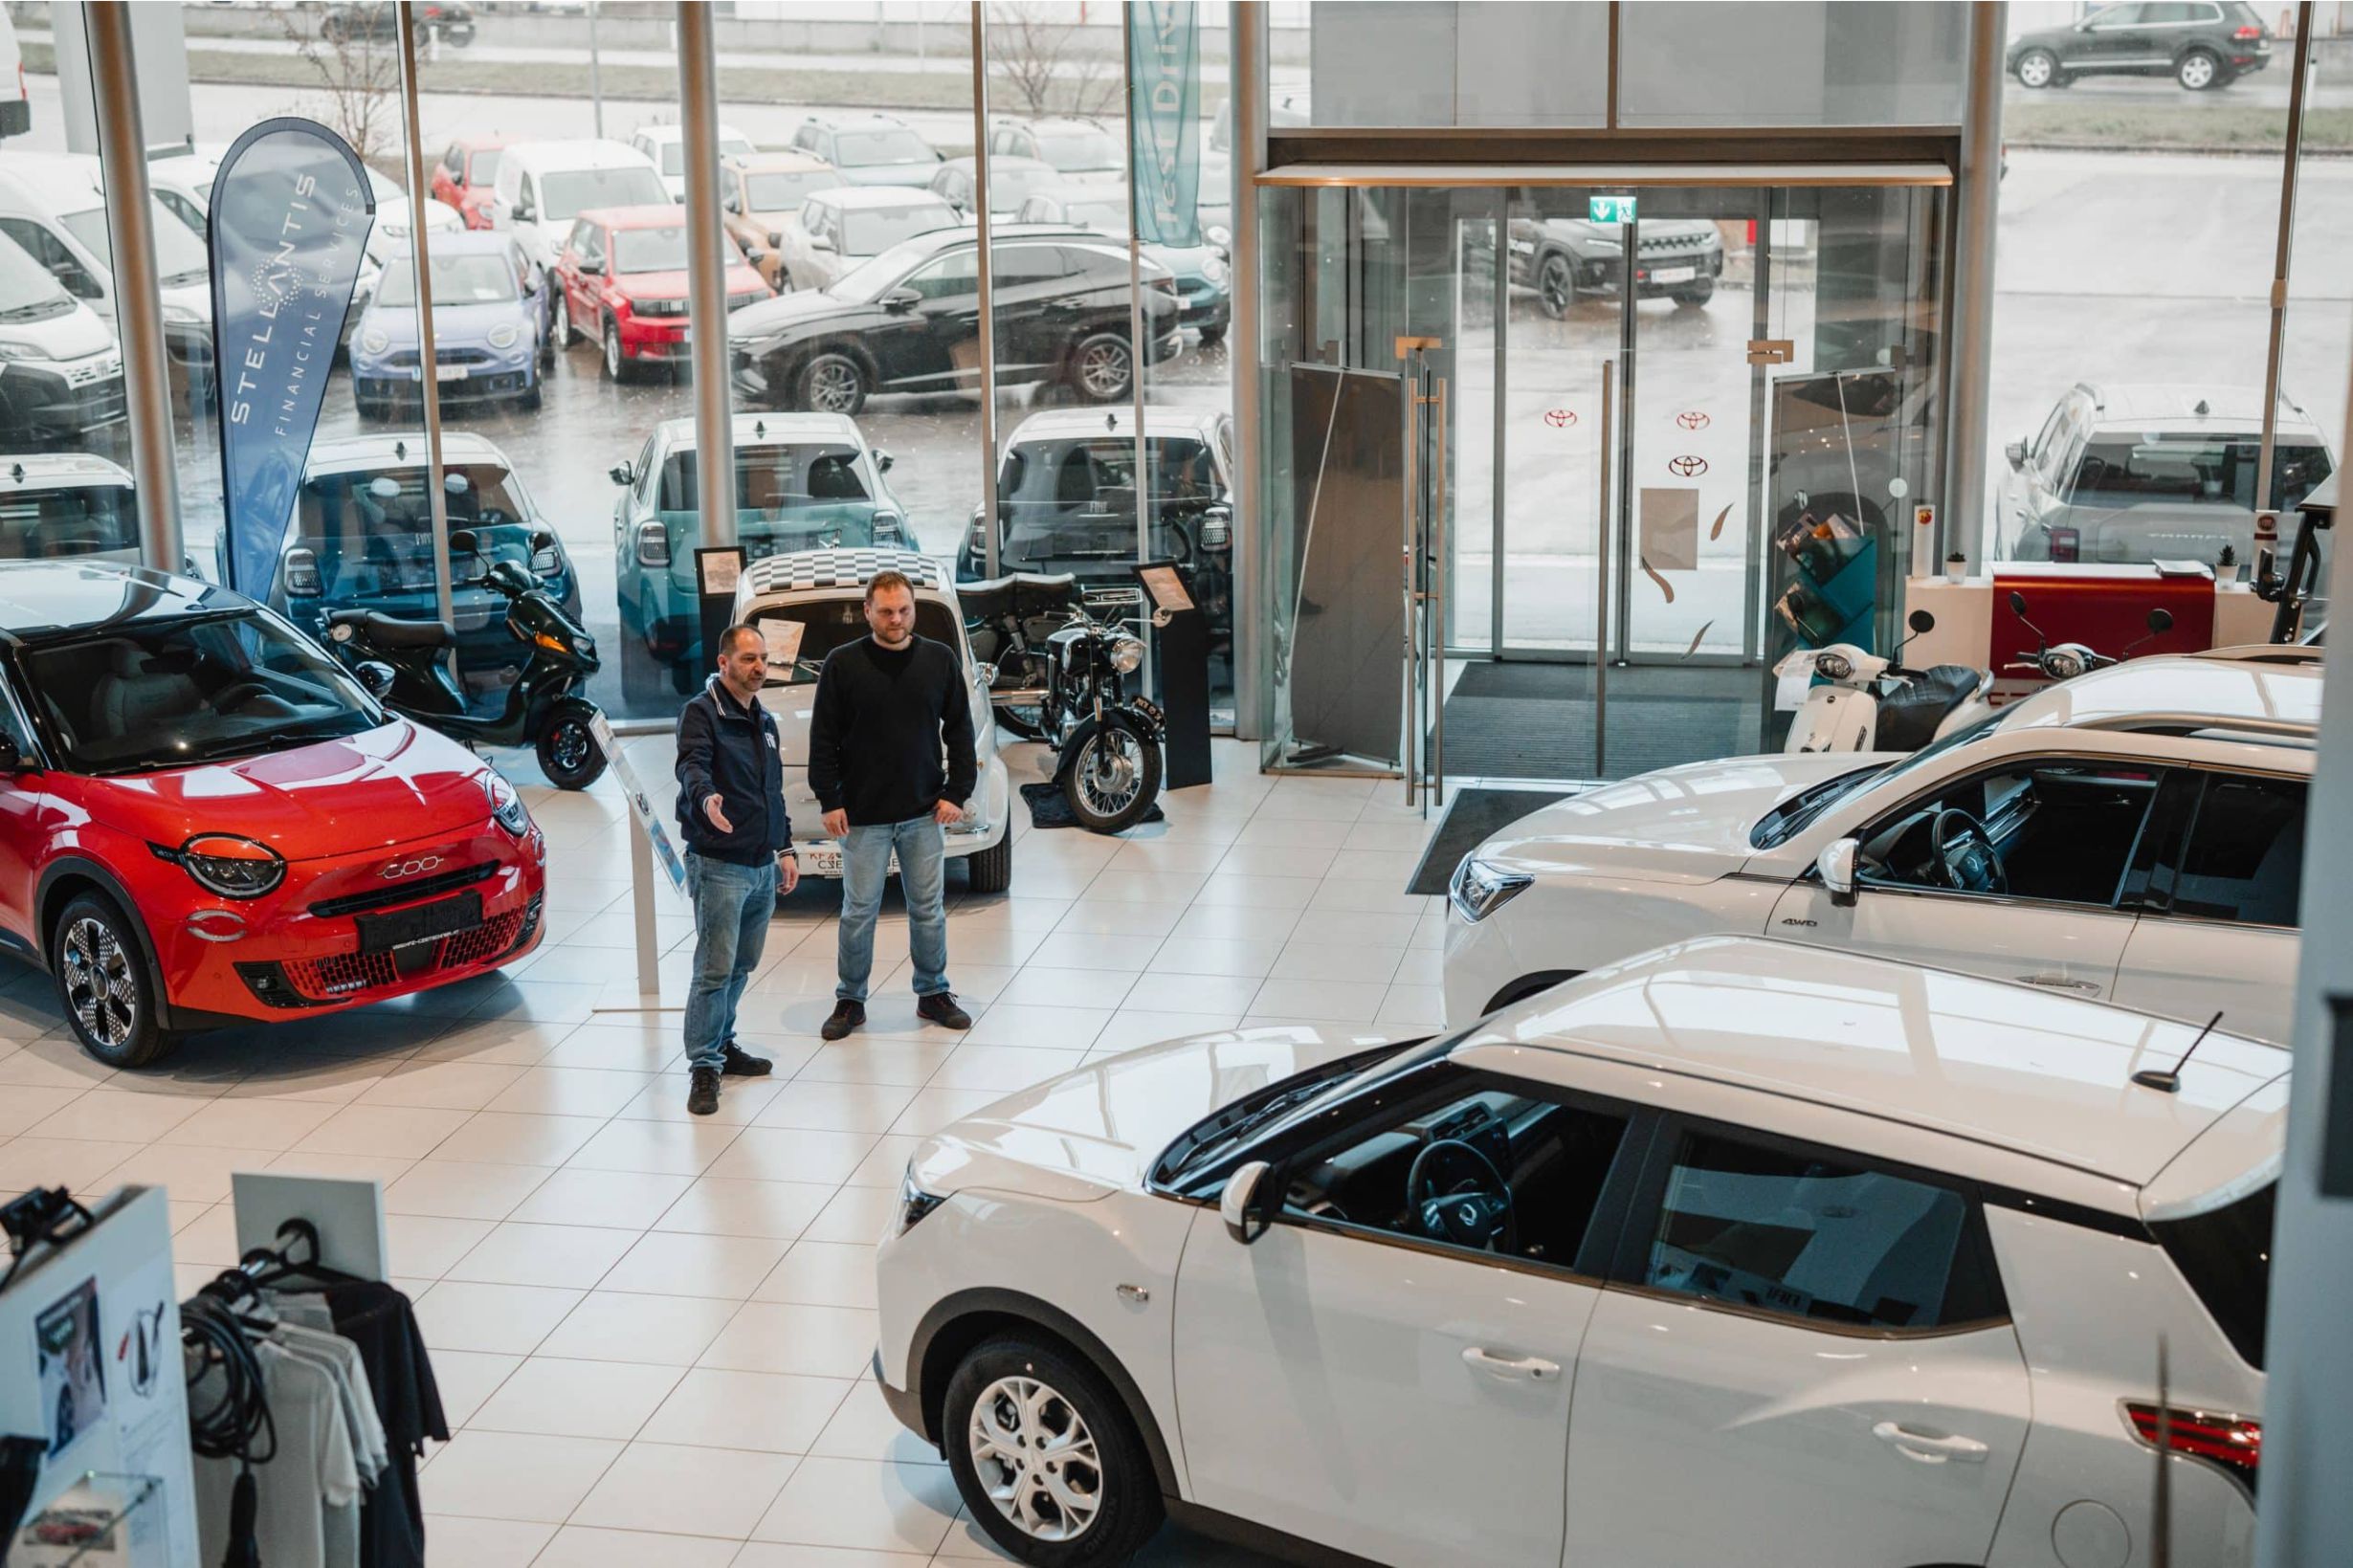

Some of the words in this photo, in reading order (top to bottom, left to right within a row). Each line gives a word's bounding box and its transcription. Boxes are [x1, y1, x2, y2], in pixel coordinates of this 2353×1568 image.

[1152, 1, 1180, 112] Driv
[1155, 132, 1180, 229] Test
[232, 174, 316, 425] STELLANTIS
[276, 312, 322, 437] FINANCIAL
[315, 188, 358, 298] SERVICES
[1782, 917, 1818, 927] 4WD
